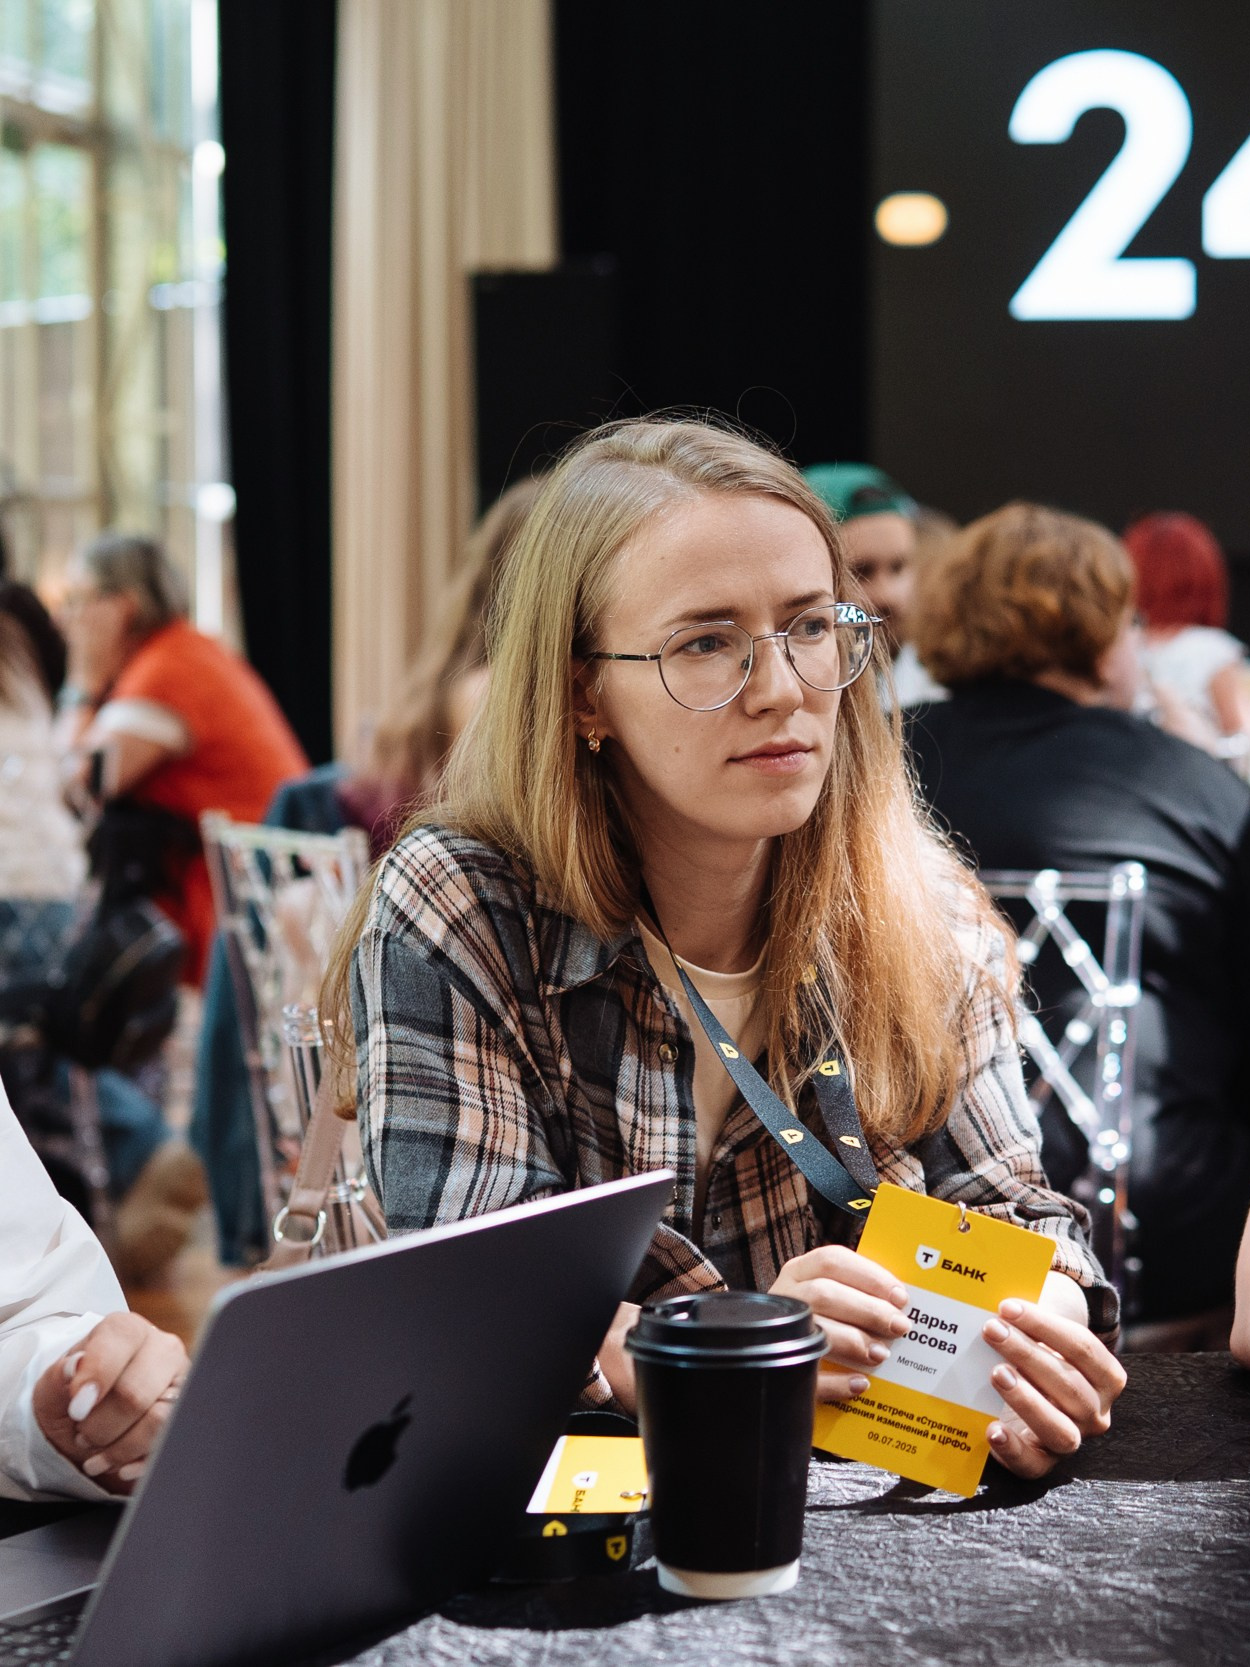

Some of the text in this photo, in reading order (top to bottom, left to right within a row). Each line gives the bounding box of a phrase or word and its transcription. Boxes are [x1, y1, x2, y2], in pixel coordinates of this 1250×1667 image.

[922, 1252, 987, 1282] Т БАНК
[907, 1307, 958, 1334] Дарья
[903, 1330, 958, 1355] осова
[896, 1356, 938, 1375] Методист
[849, 1395, 876, 1407] очая
[877, 1403, 915, 1421] встреча
[876, 1415, 929, 1438] изменений
[930, 1433, 937, 1441] в
[867, 1431, 917, 1454] 09.07.2025
[570, 1489, 586, 1512] БАН
